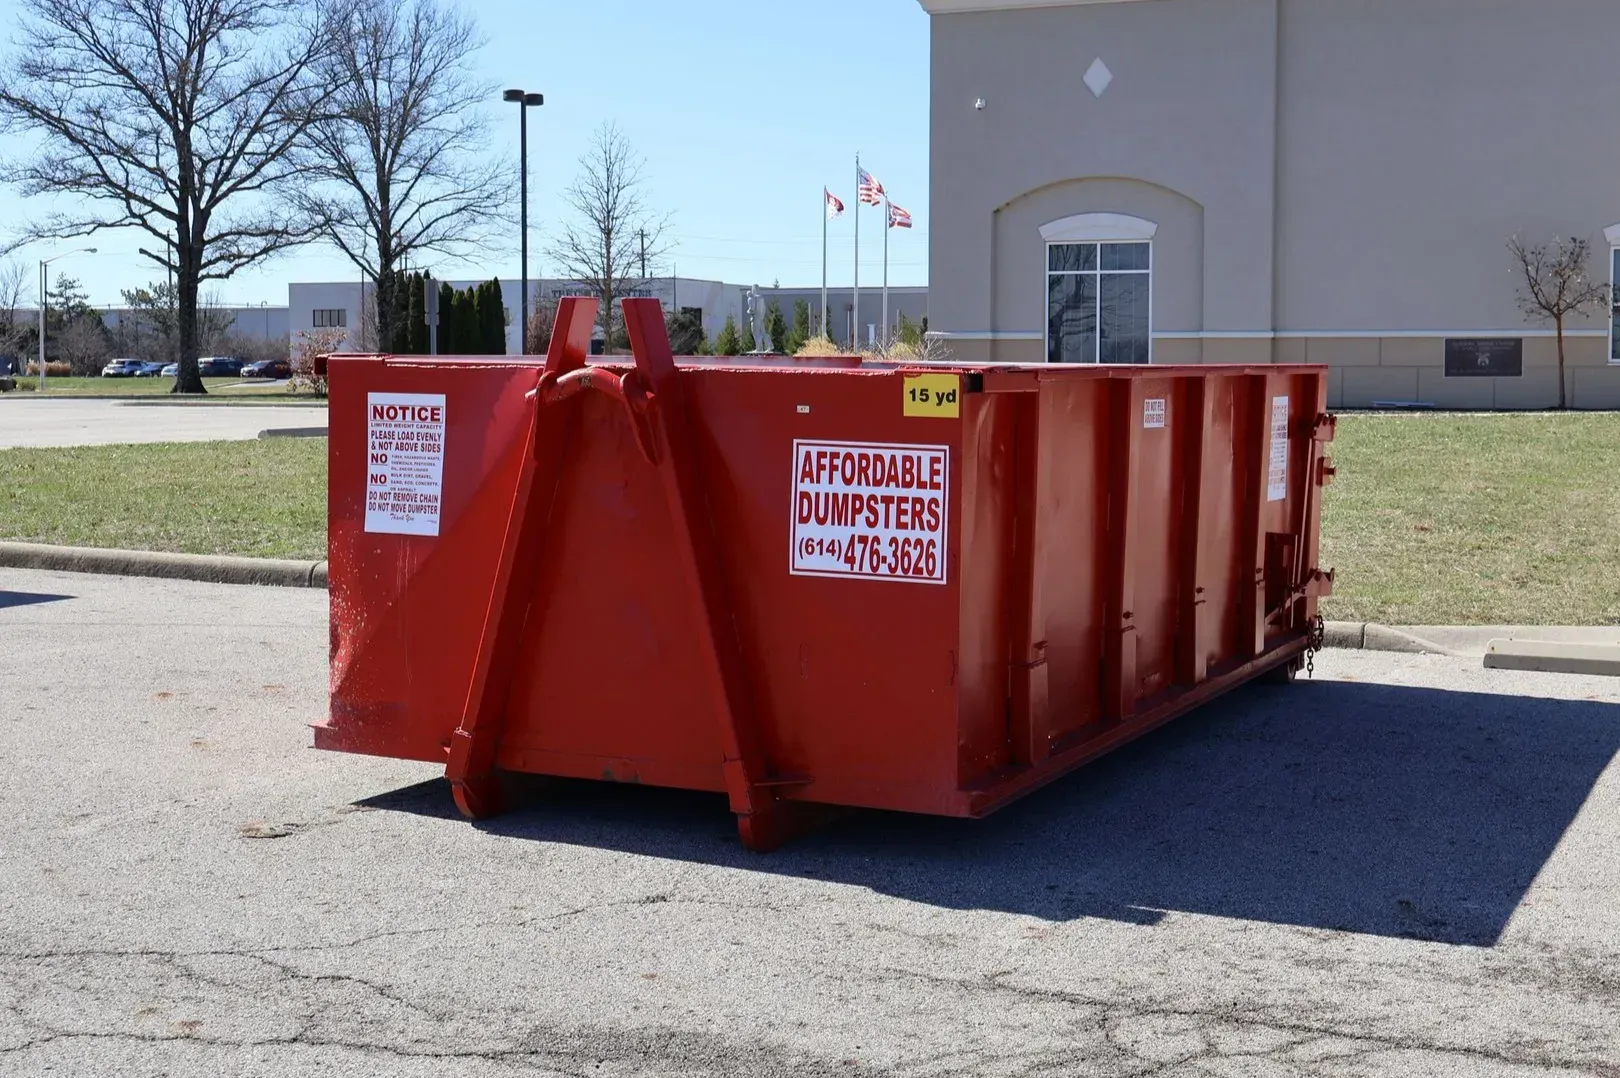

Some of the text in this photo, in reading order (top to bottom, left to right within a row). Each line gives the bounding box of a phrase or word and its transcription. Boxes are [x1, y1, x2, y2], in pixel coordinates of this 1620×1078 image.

[909, 388, 956, 406] 15 yd
[373, 406, 440, 422] NOTICE
[371, 430, 442, 442] PLEASE LOAD EVENLY
[371, 441, 441, 453] & NOT ABOVE SIDES
[371, 453, 388, 464] NO
[800, 450, 942, 490] AFFORDABLE
[371, 474, 387, 484] NO
[369, 491, 438, 503] DO NOT REMOVE CHAIN
[369, 502, 438, 515] DO NOT MOVE DUMPSTER
[798, 491, 940, 532] DUMPSTERS
[405, 514, 414, 523] You
